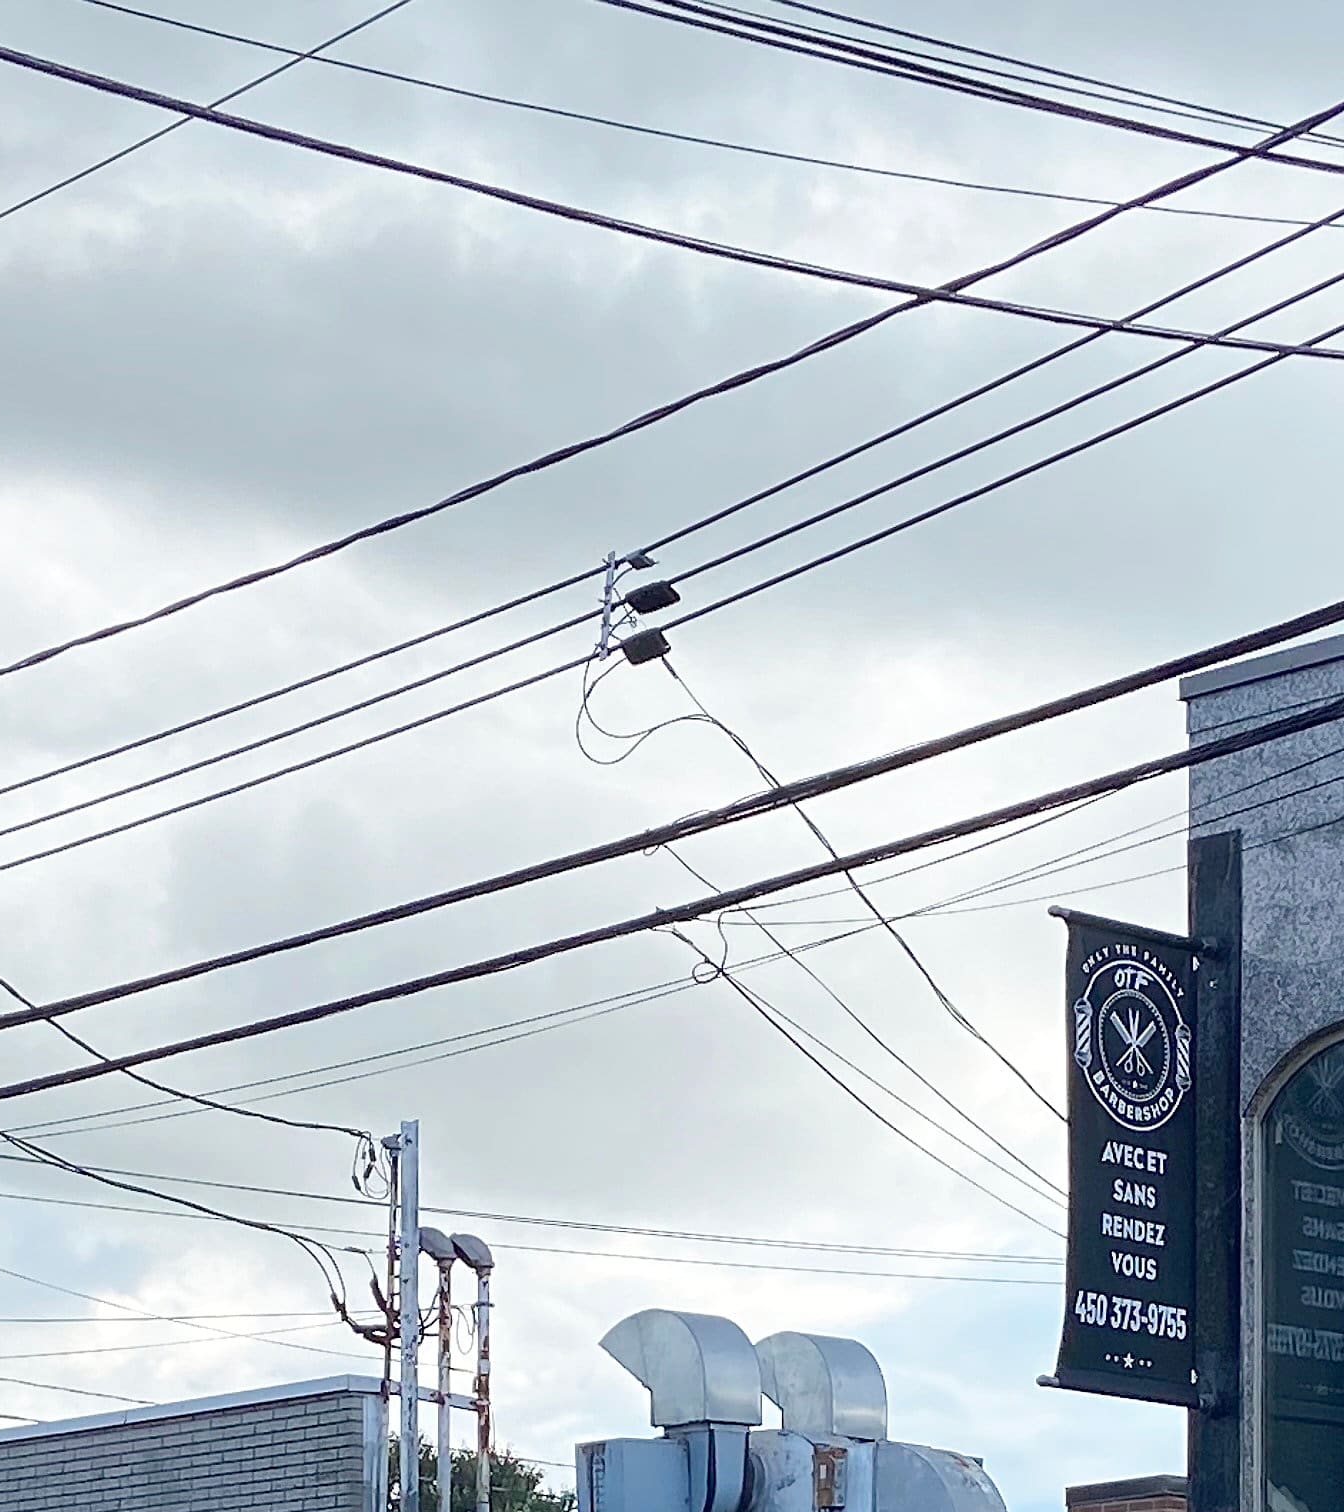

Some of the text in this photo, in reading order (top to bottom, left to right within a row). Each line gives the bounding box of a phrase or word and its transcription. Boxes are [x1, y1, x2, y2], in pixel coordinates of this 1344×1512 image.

[1114, 967, 1155, 991] OTF
[1115, 944, 1138, 957] THE
[1143, 951, 1184, 998] FAMILY
[1092, 1069, 1175, 1122] BARBERSHOP
[1101, 1140, 1168, 1175] AVEC ET
[1112, 1178, 1157, 1209] SANS
[1101, 1212, 1167, 1246] RENDEZ
[1111, 1250, 1157, 1281] VOUS
[1075, 1290, 1187, 1341] 450 373-9755
